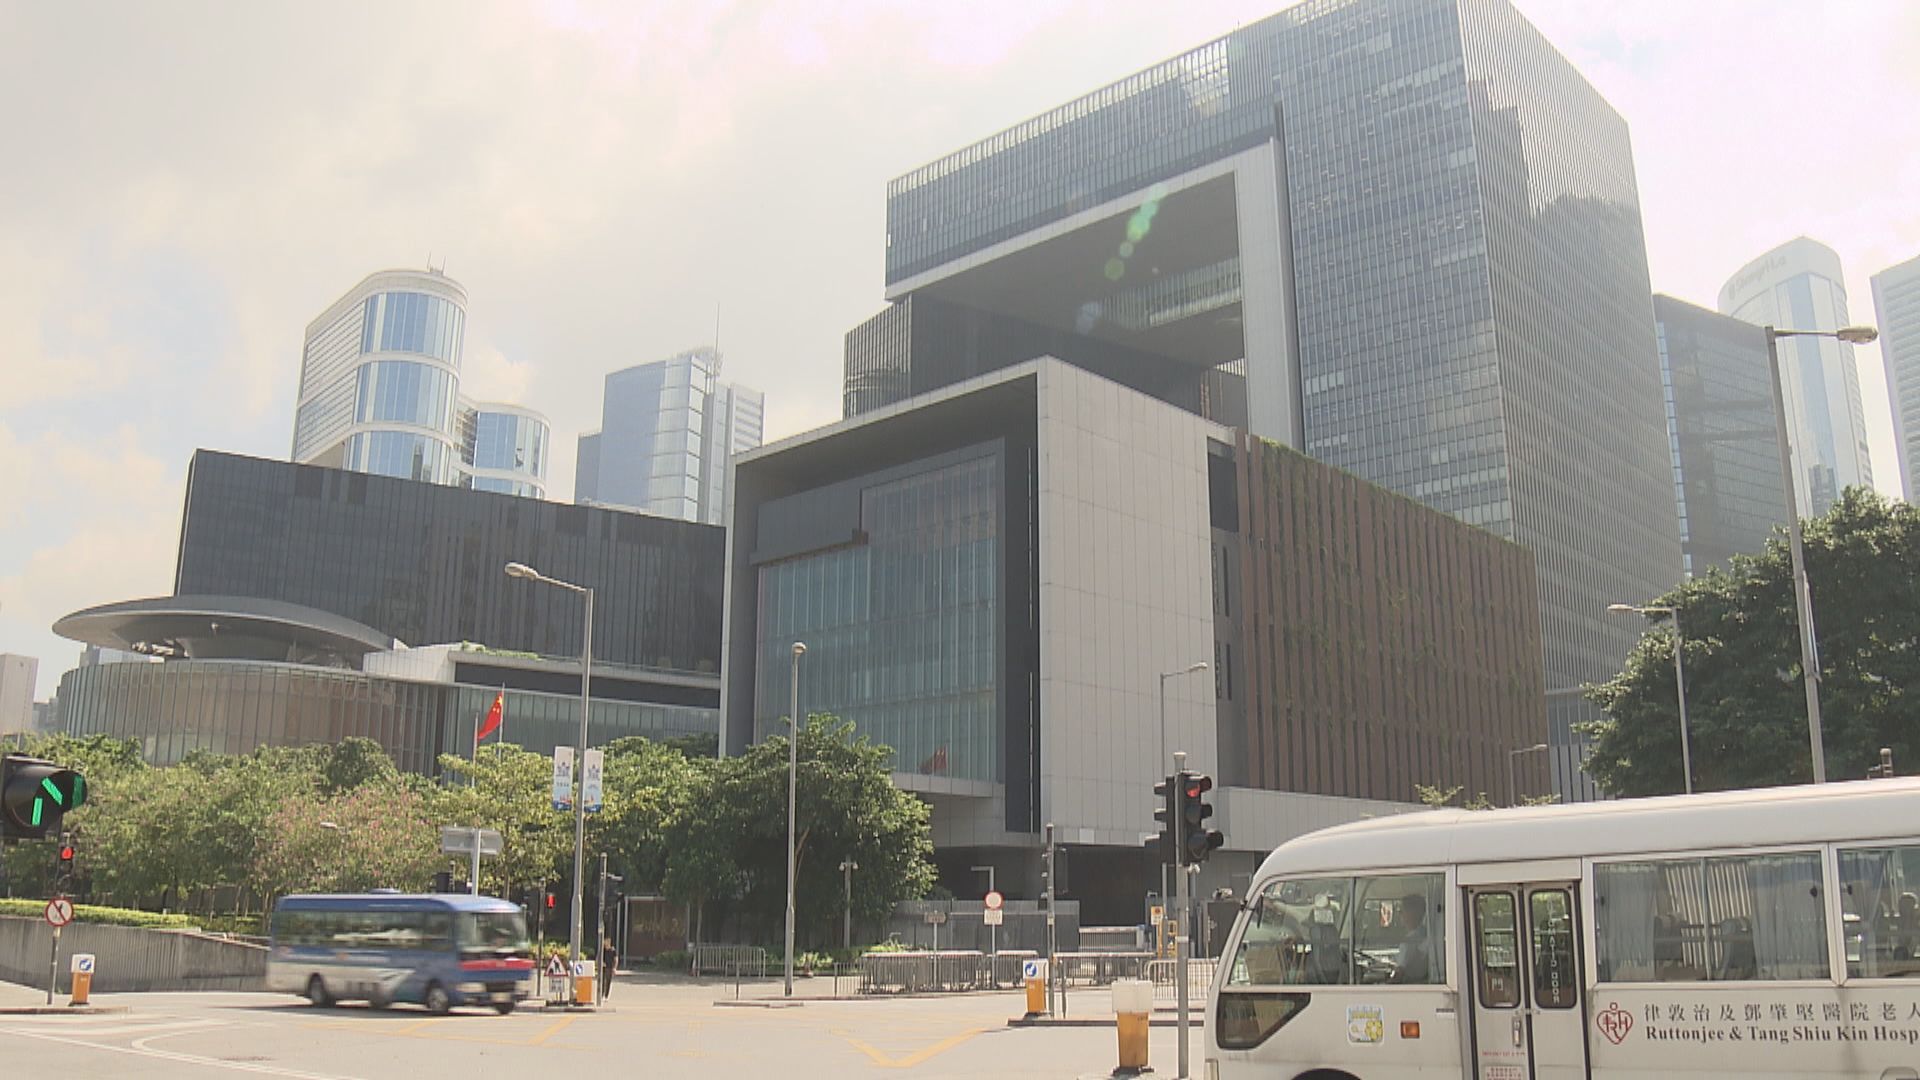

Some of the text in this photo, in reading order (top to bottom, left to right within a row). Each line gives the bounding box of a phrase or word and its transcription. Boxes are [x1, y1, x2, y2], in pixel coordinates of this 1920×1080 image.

[1646, 1025, 1919, 1045] Ruttonjee & Tang Shiu Kin Hosp
